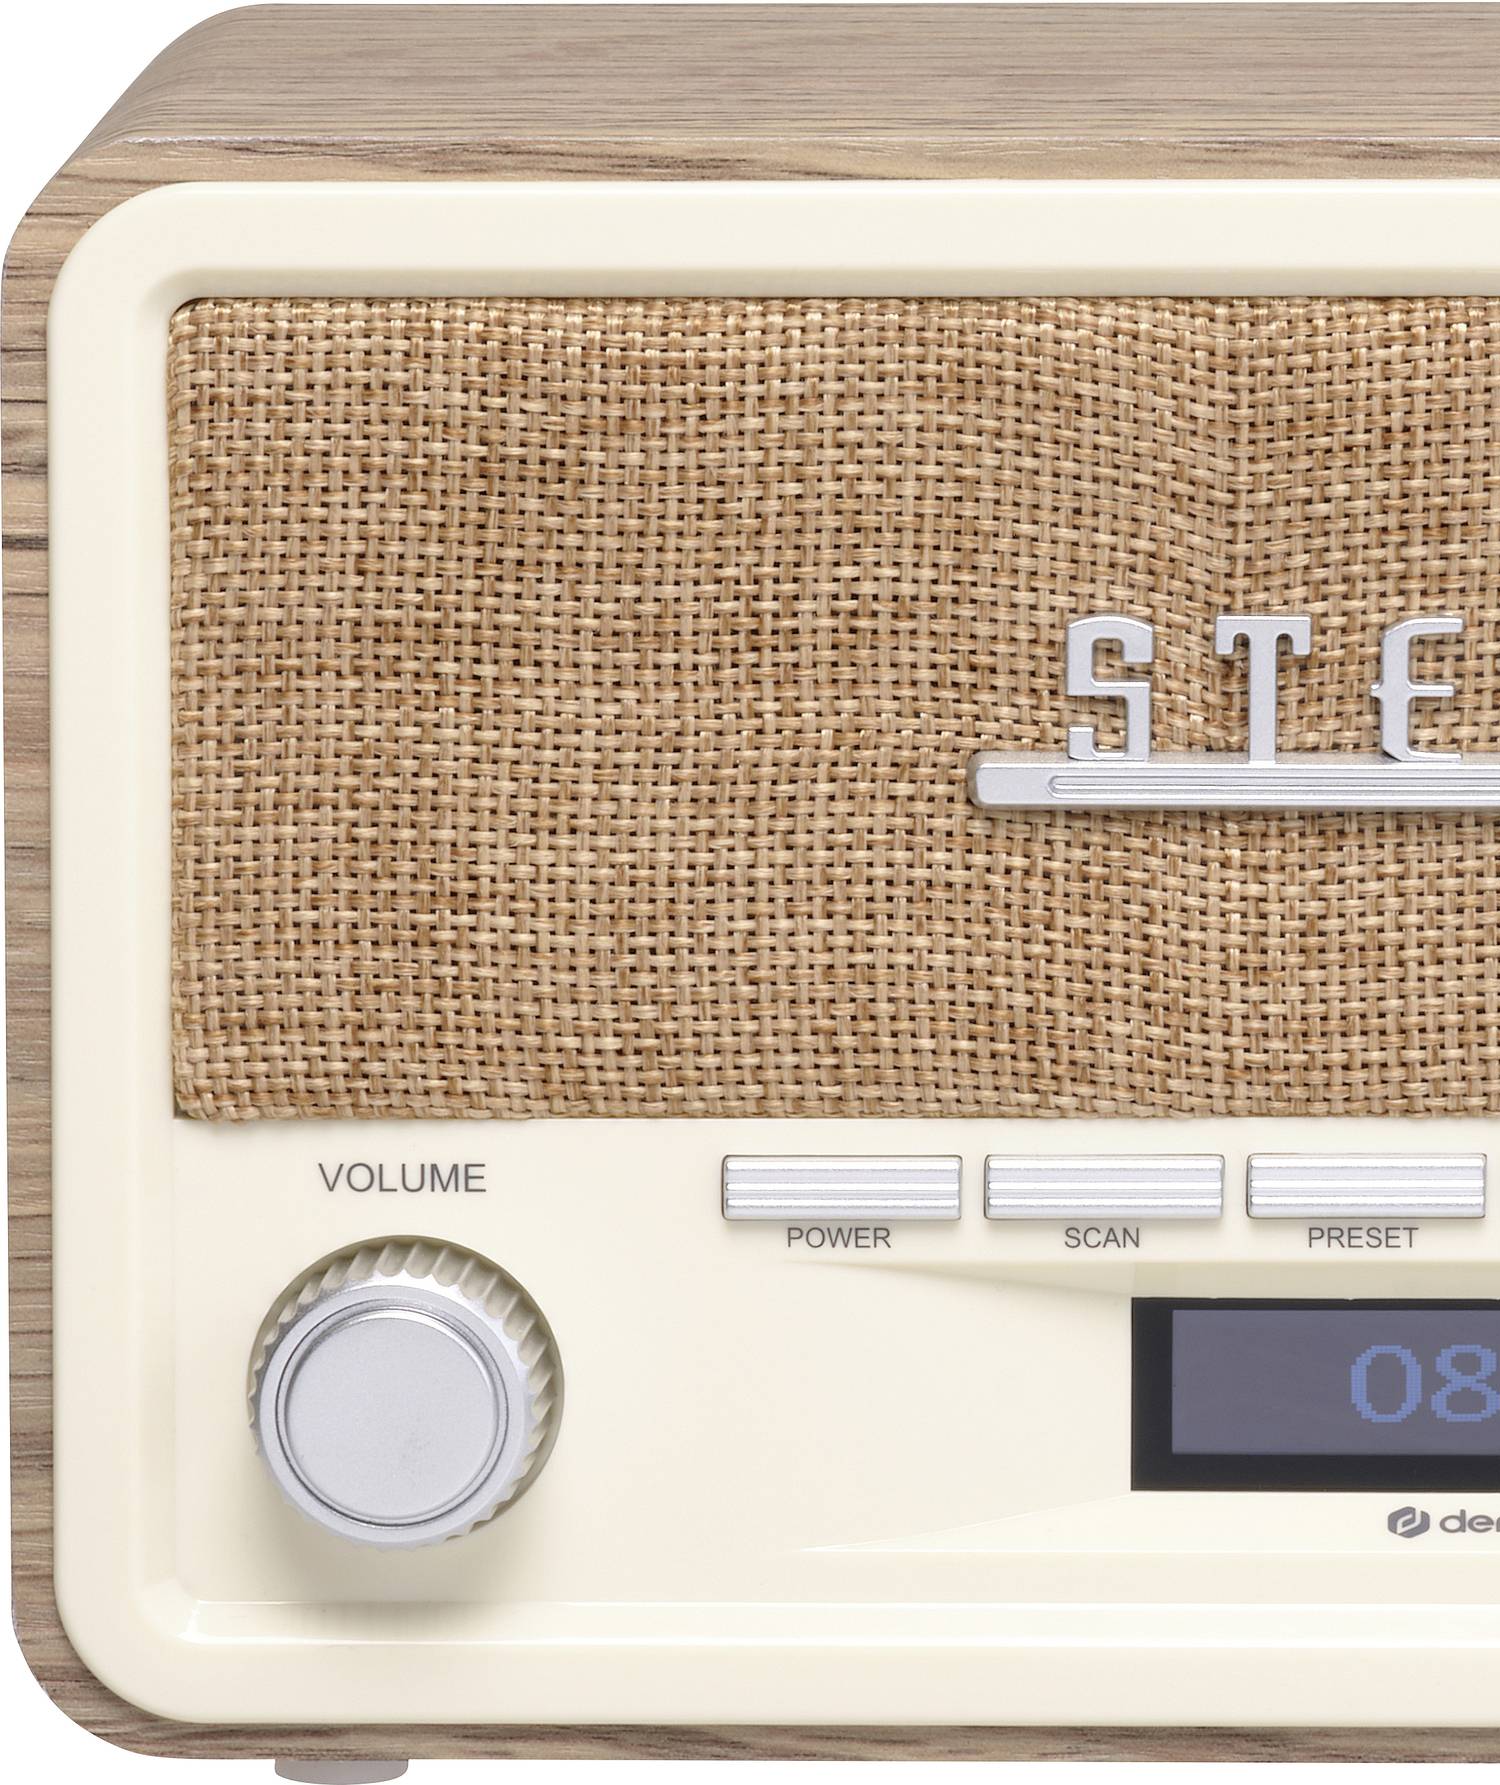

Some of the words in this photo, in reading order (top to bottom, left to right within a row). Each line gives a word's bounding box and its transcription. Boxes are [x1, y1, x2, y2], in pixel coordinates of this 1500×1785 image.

[318, 1162, 487, 1193] VOLUME
[786, 1226, 892, 1250] POWER
[1063, 1226, 1141, 1250] SCAN
[1307, 1226, 1419, 1250] PRESET
